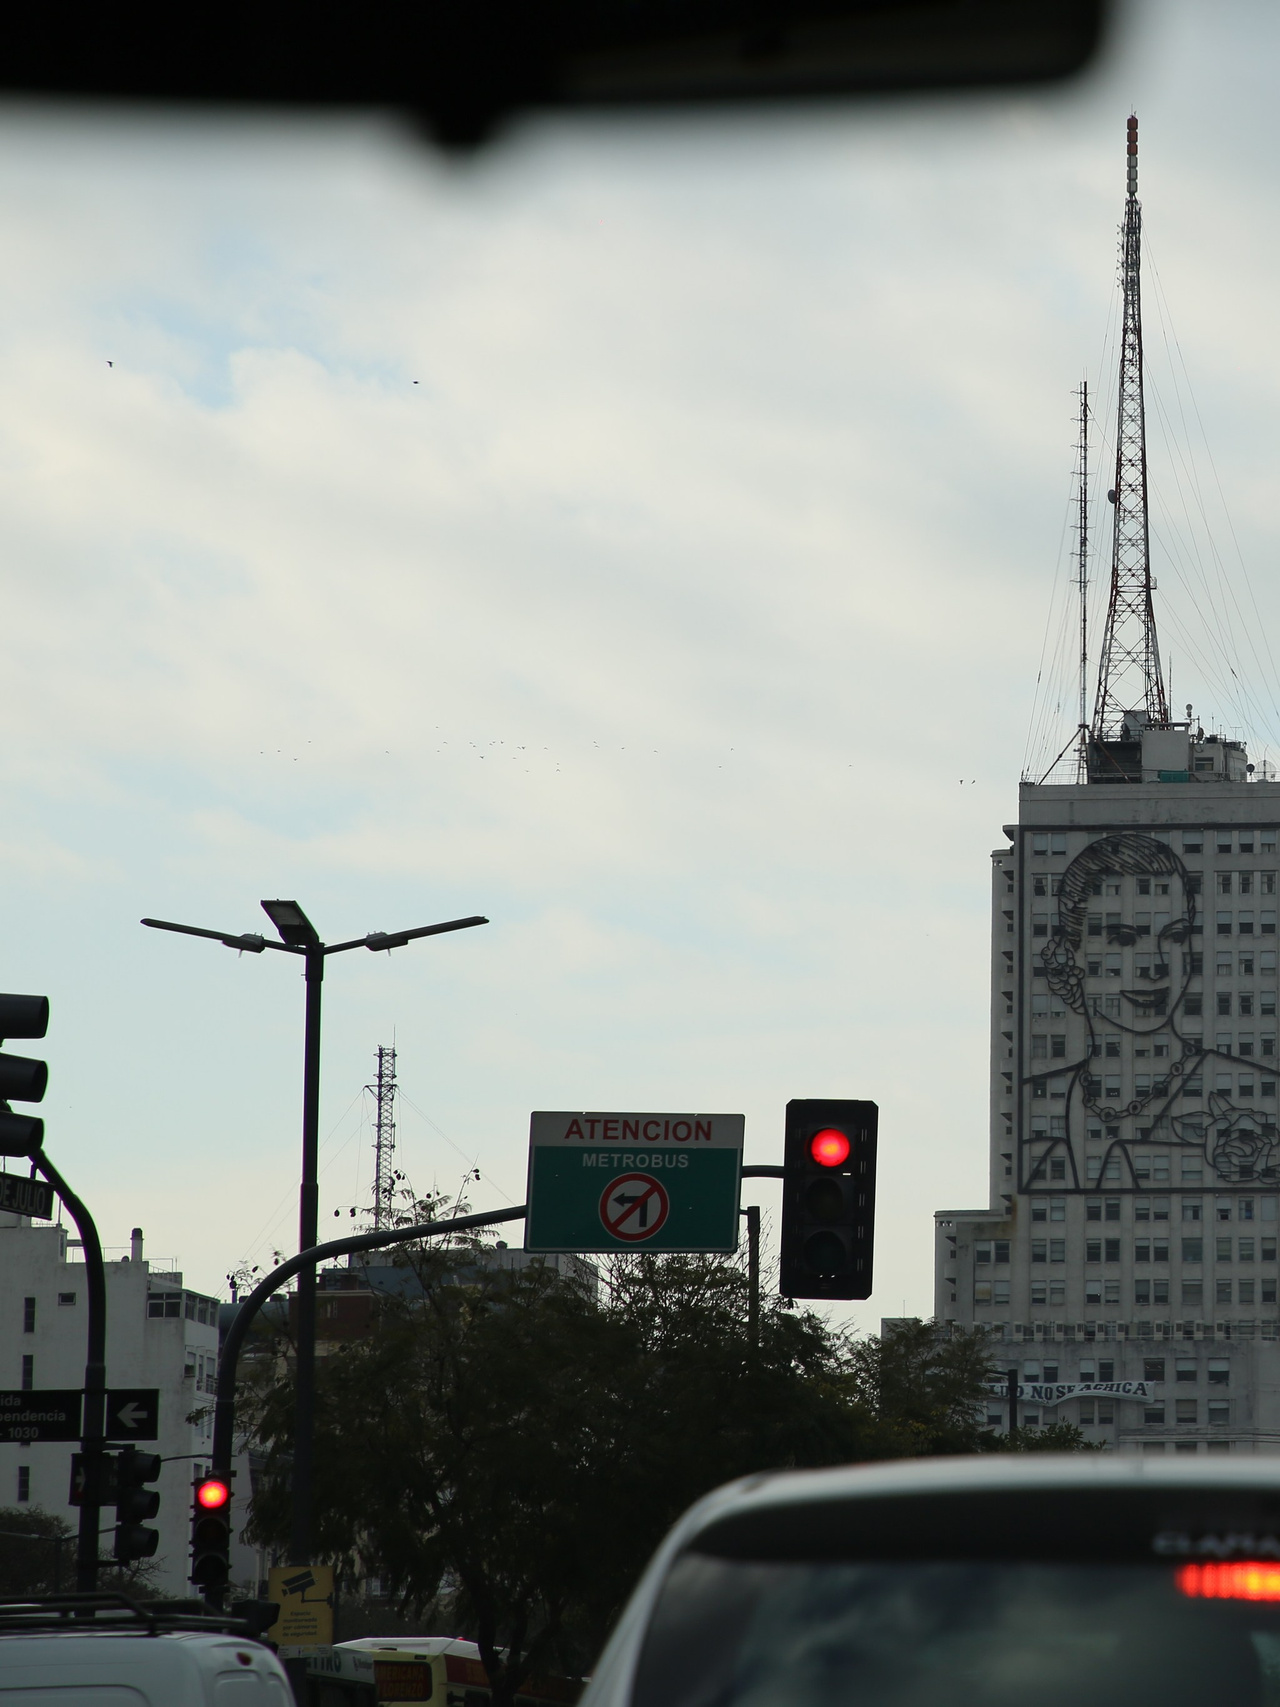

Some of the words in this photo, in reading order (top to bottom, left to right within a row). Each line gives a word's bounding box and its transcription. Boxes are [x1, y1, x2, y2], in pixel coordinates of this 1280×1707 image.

[564, 1118, 713, 1142] ATENCION
[582, 1153, 689, 1168] METROBUS
[12, 1181, 46, 1214] JULIO
[8, 1426, 39, 1439] 1030
